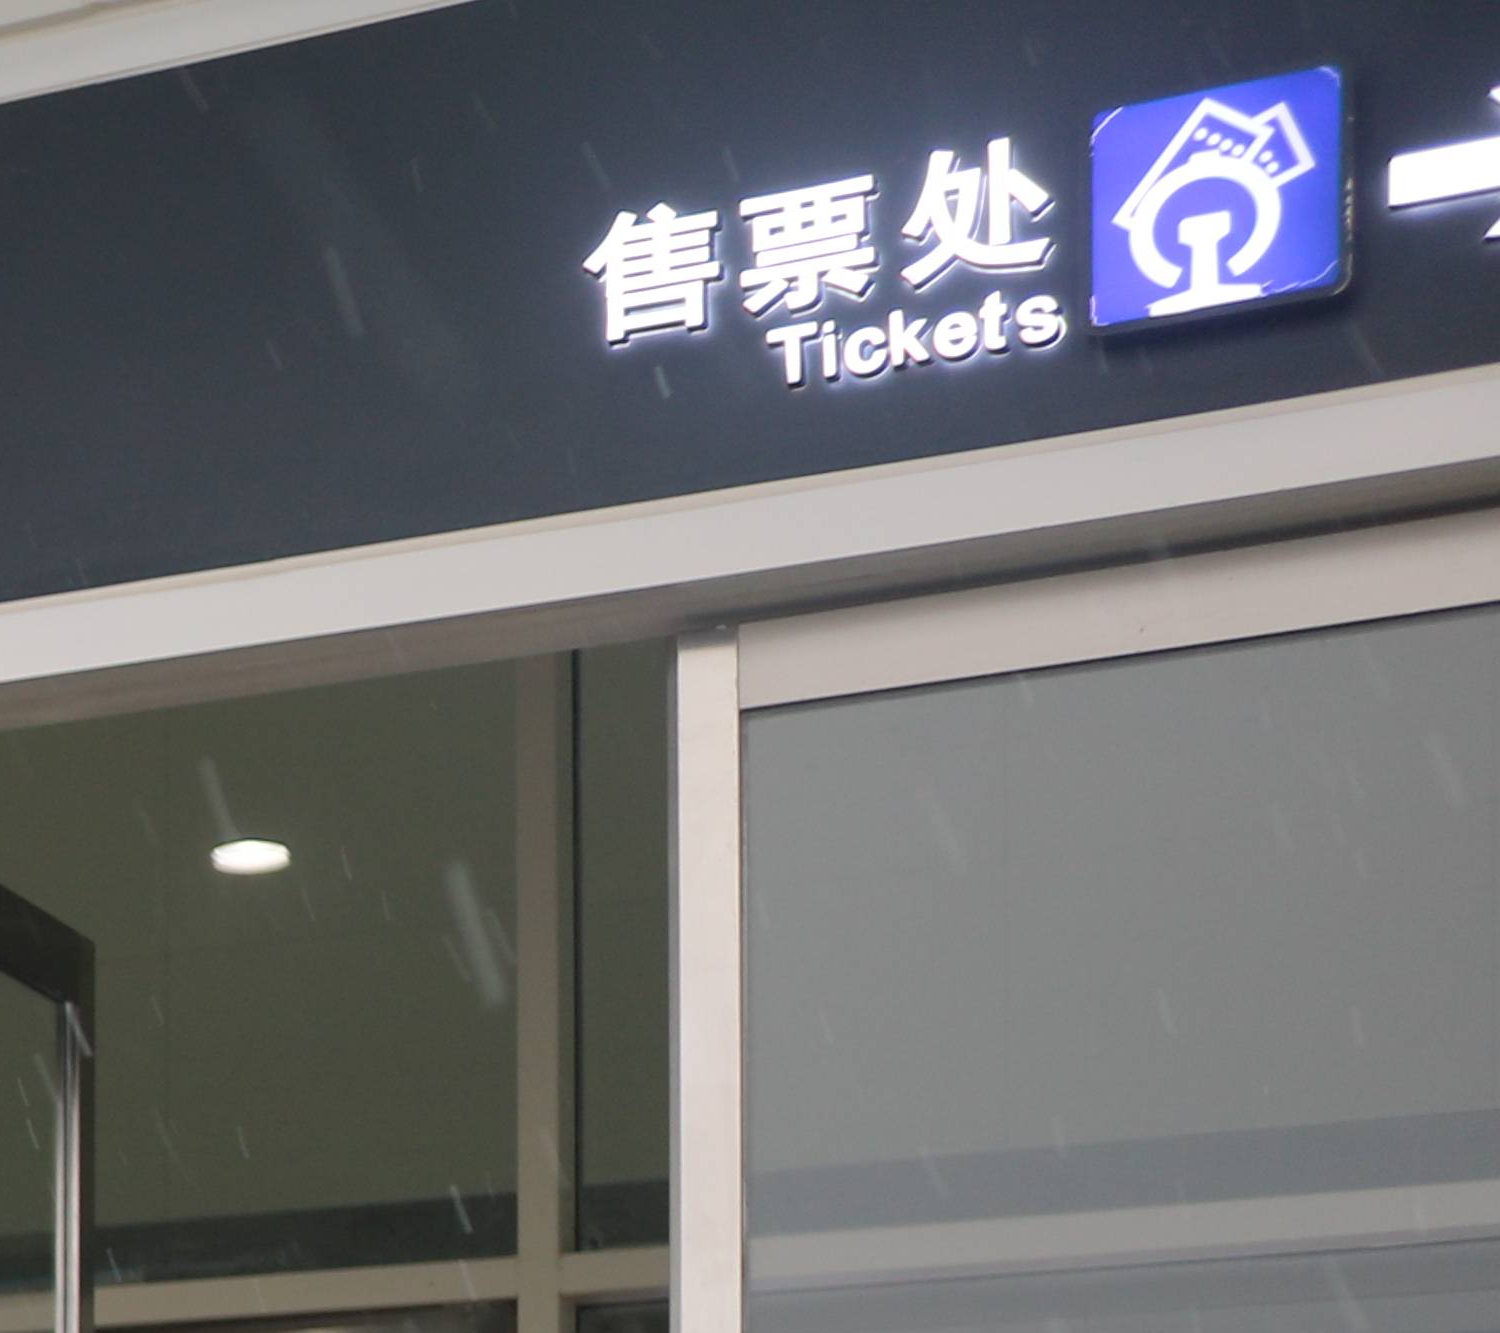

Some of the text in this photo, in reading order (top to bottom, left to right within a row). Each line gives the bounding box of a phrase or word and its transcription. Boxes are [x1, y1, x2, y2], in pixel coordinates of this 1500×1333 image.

[583, 136, 1050, 344] 售票处
[766, 290, 1066, 386] Tickets
